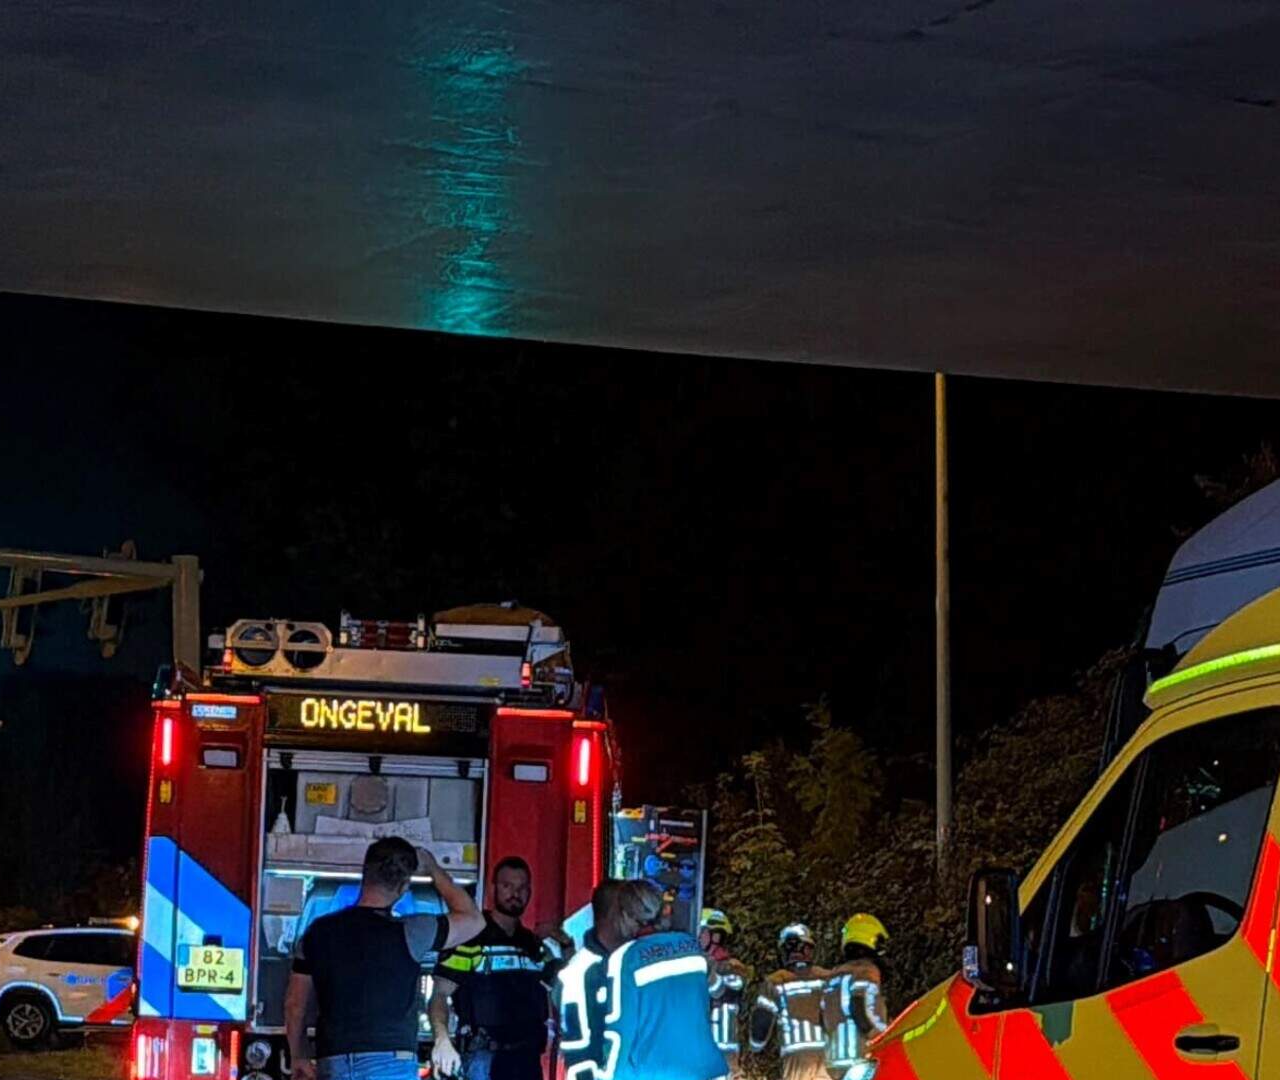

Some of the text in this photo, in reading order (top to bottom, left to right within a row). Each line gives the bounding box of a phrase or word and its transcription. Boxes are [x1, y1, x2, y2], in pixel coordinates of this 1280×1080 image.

[301, 698, 431, 733] ONGEVAL
[203, 950, 225, 965] 82
[185, 968, 235, 984] BPR-4
